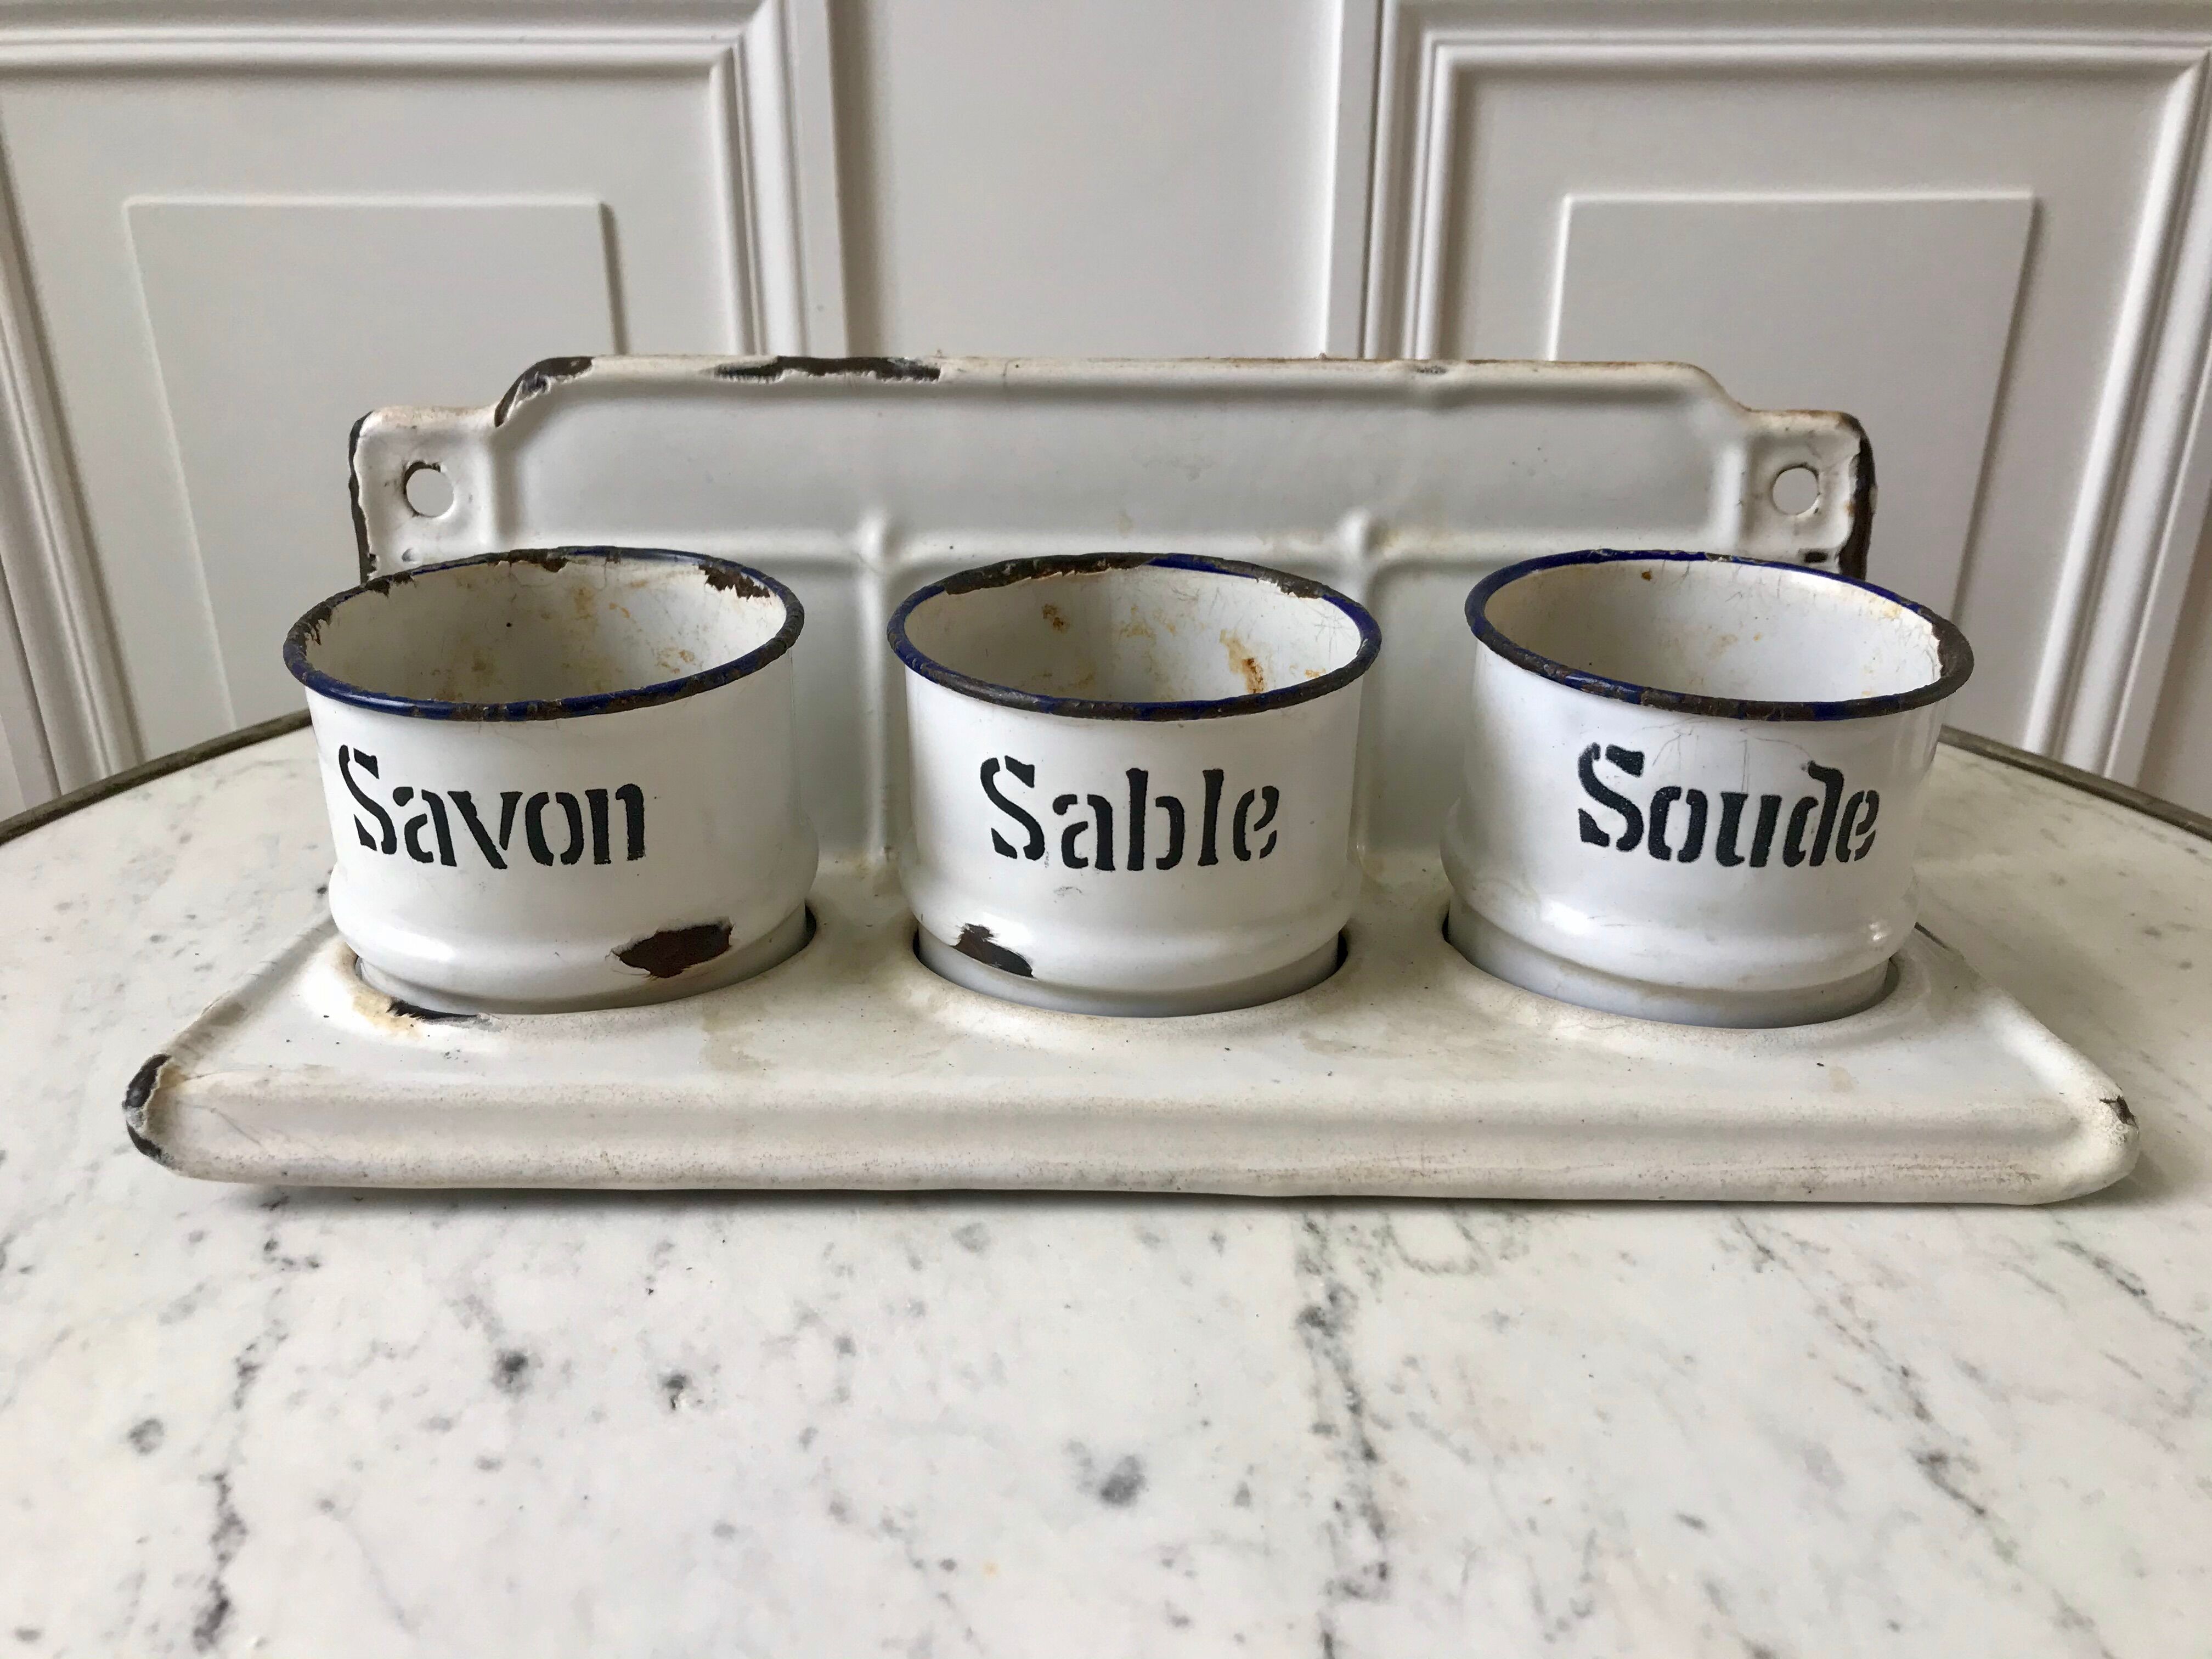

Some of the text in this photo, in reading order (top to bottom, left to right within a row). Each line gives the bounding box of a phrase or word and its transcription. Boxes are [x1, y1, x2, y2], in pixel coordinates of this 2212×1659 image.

[338, 744, 646, 870] Savon
[980, 755, 1280, 872] Sable
[1578, 743, 1881, 868] Soude
